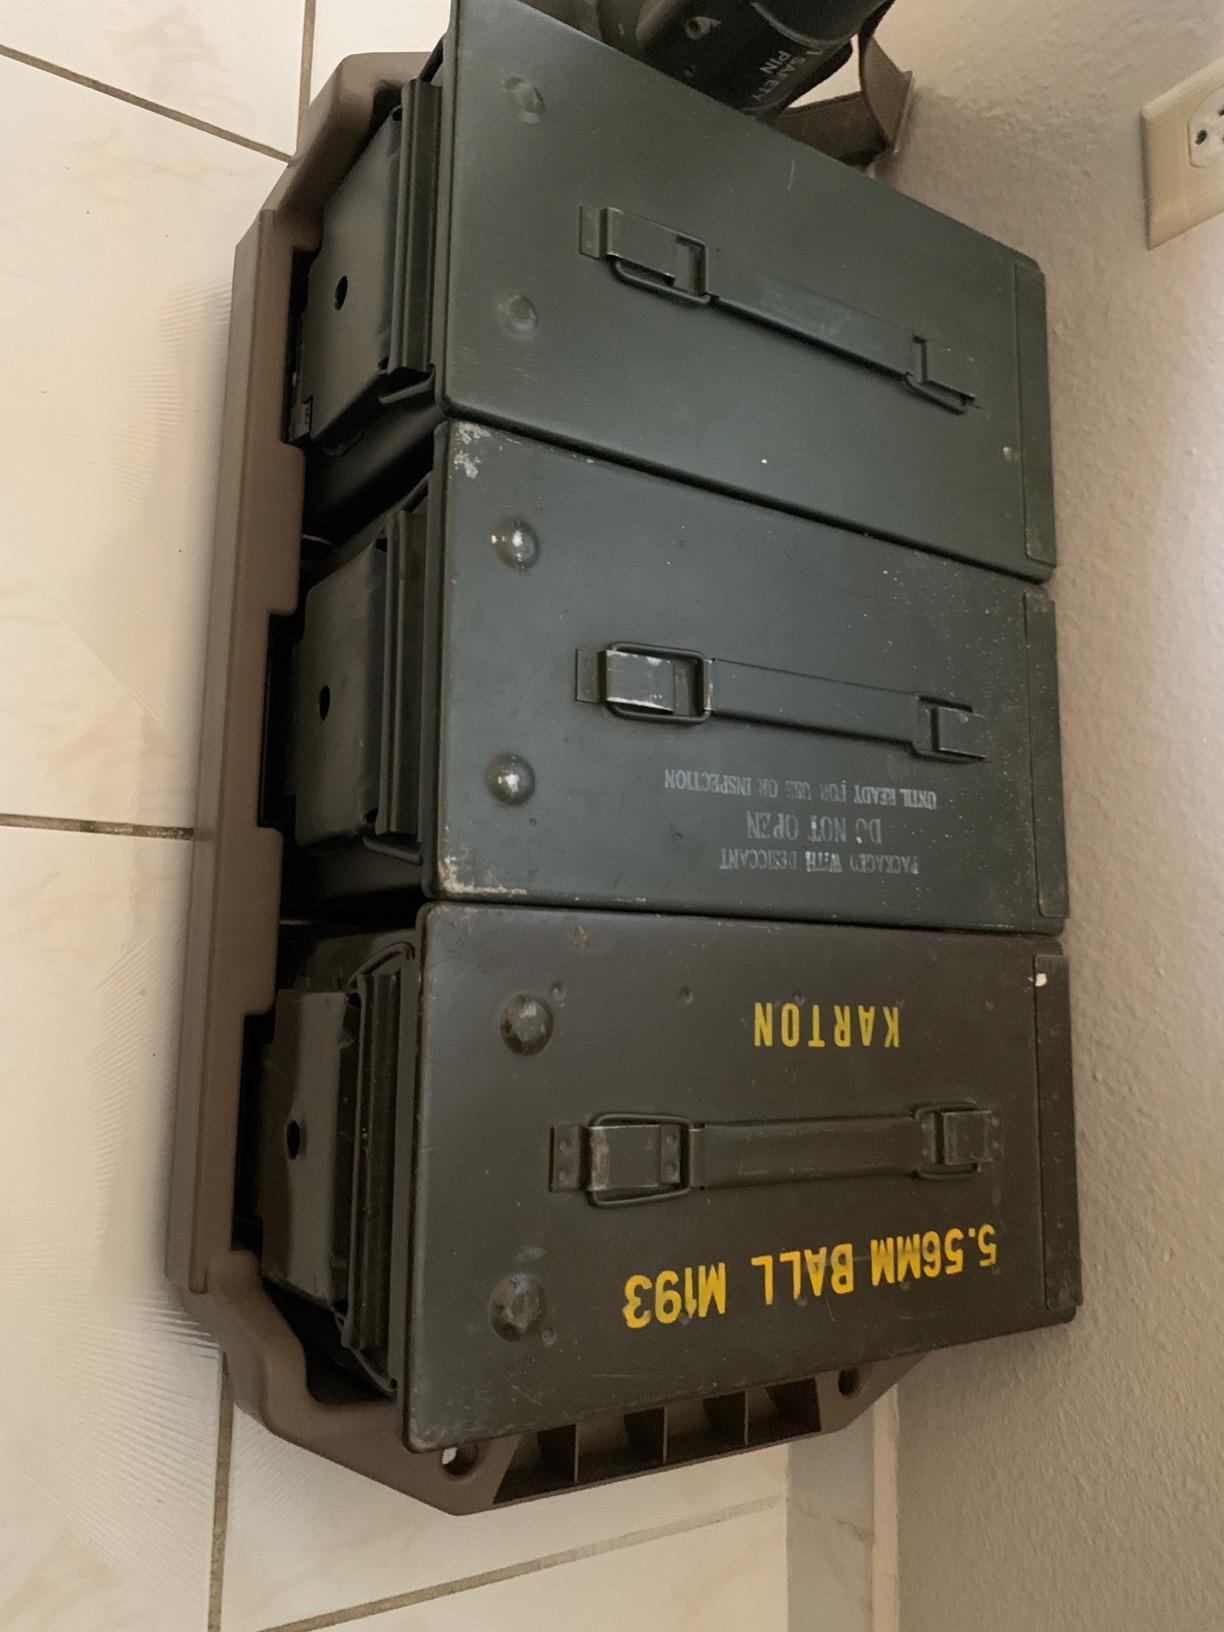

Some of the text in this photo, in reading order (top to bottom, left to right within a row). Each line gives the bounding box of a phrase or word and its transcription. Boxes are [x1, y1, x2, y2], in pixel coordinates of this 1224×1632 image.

[759, 50, 790, 75] PIN
[664, 768, 751, 796] INSPECTION
[757, 777, 778, 798] OR
[854, 784, 896, 806] READY
[745, 811, 799, 841] OPEN
[807, 815, 847, 843] NOT
[718, 847, 797, 871] DESICCANT
[805, 850, 842, 873] WITH
[753, 1002, 900, 1048] KARTON
[622, 1223, 998, 1329] 5.56MM BALL M193
